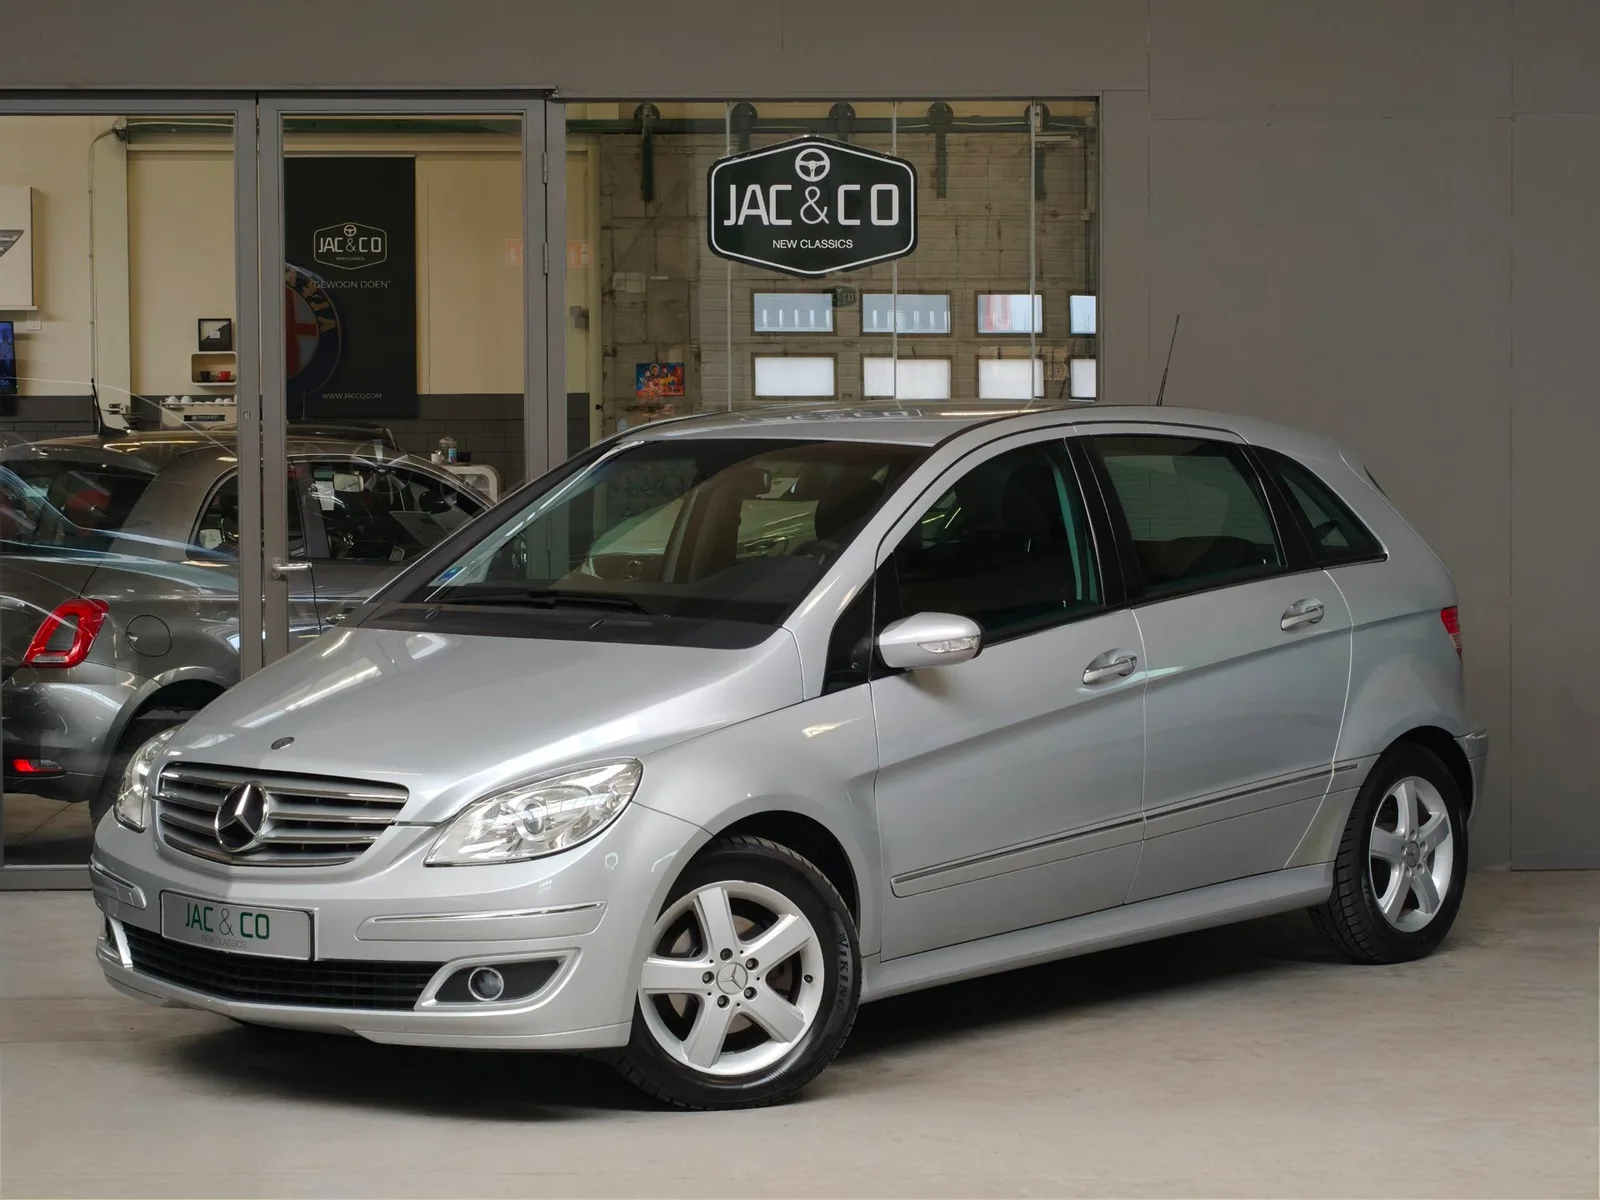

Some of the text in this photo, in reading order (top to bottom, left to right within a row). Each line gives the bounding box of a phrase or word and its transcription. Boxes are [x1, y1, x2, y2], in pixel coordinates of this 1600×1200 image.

[723, 184, 900, 226] JAC & CO
[318, 237, 382, 253] JAC & CO
[772, 239, 854, 249] NEW CLASSICS
[185, 902, 270, 940] JAC & CO
[202, 935, 248, 950] NEW CLASSICS
